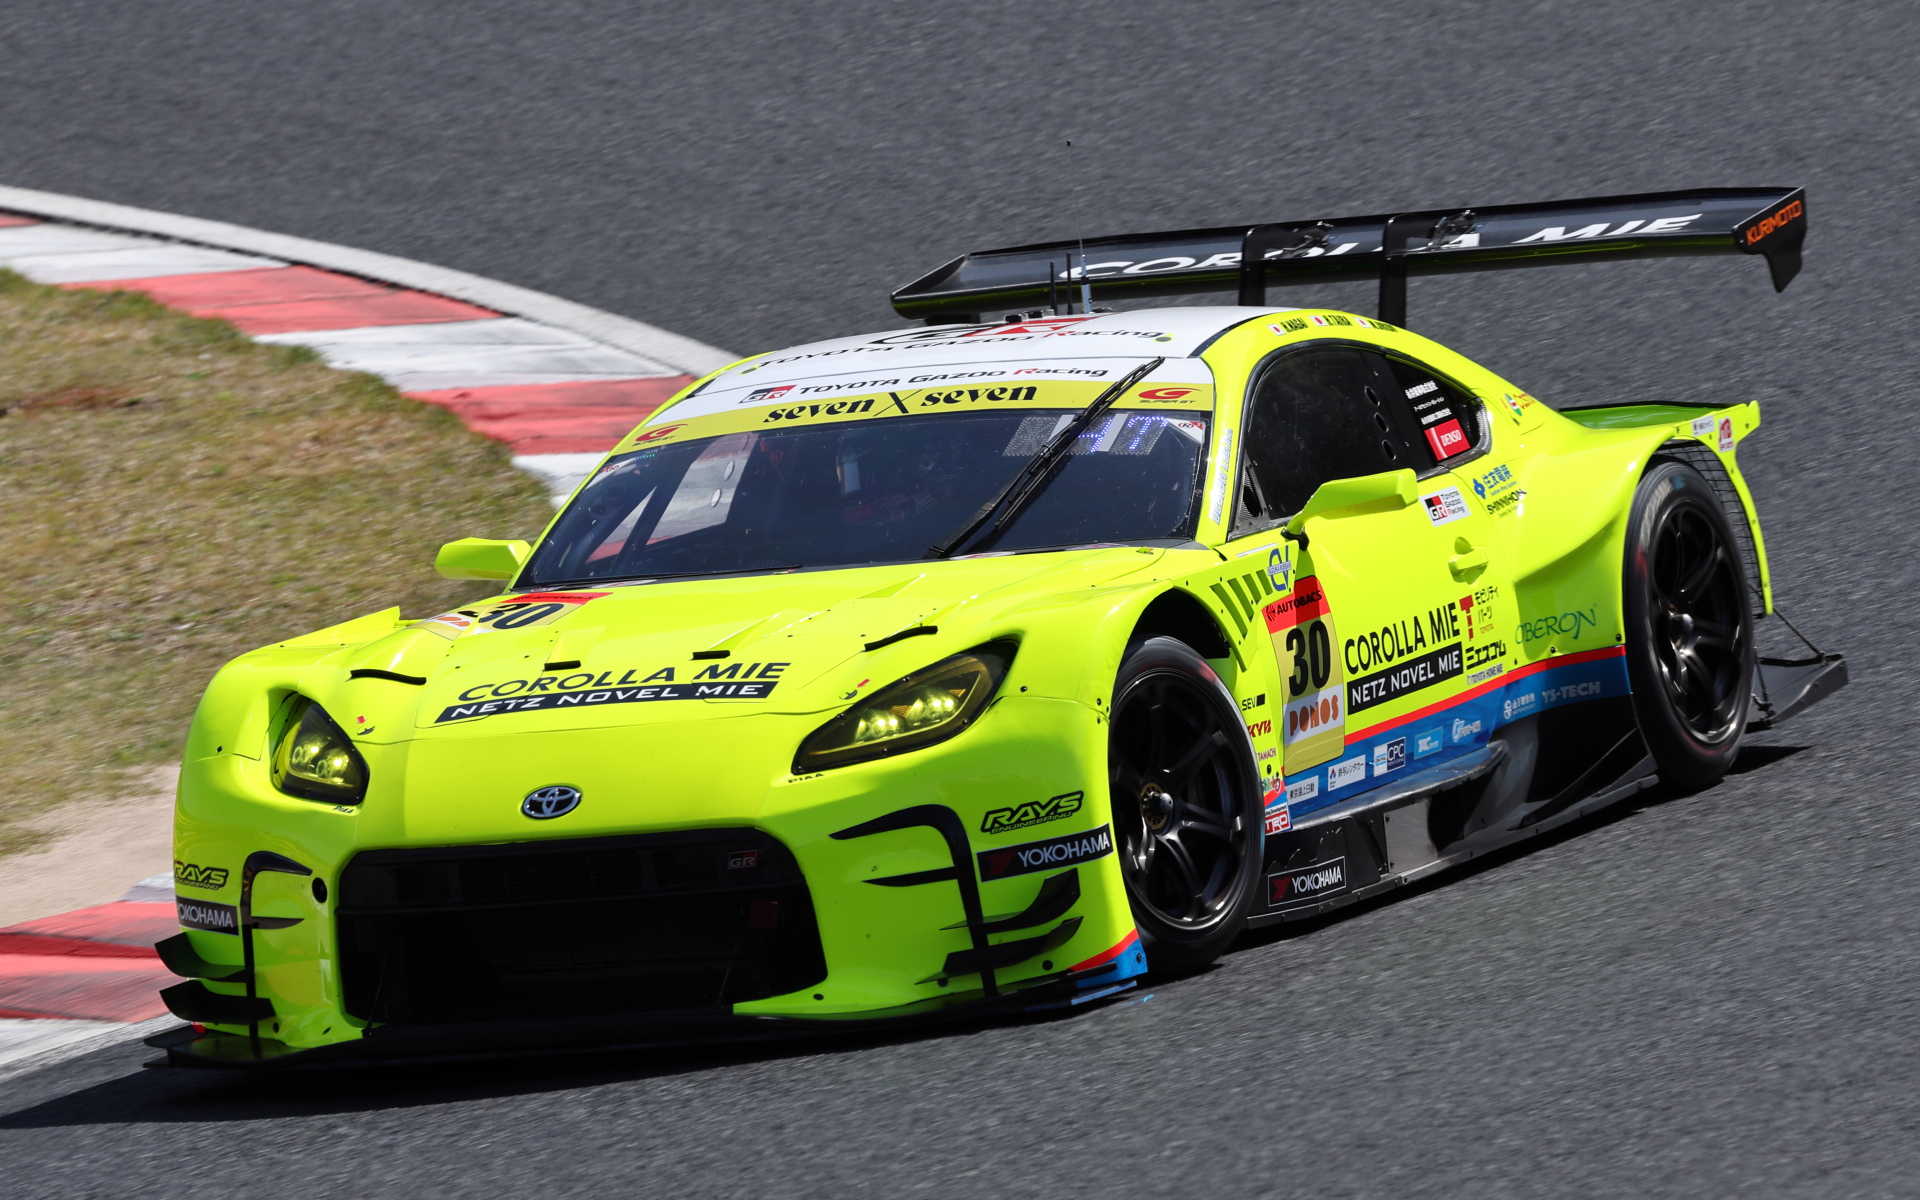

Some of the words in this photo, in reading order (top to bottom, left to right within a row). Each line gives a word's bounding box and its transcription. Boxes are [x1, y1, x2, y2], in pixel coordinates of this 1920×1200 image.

[1511, 213, 1703, 244] MIE
[1746, 200, 1803, 246] KURIMOTO
[757, 345, 894, 368] TOYOTA
[903, 336, 1034, 350] GAZOO
[1042, 330, 1165, 340] Racing
[800, 377, 900, 395] TOYOTA
[908, 370, 1005, 384] GAZOO
[1013, 367, 1109, 378] Racing
[763, 399, 875, 423] seven
[873, 389, 923, 417] X
[920, 385, 1038, 407] seven
[1440, 429, 1463, 447] DENSO
[1430, 502, 1448, 521] GR
[1447, 506, 1466, 517] Racing
[1277, 590, 1322, 615] AUTOBACS
[457, 603, 565, 629] 30
[1515, 609, 1596, 645] OBERON
[1345, 615, 1426, 675] COROLLA
[1428, 601, 1460, 645] MIE
[1286, 620, 1331, 697] 30
[1465, 640, 1507, 670] ミエスコム
[458, 667, 675, 701] COROLLA
[693, 662, 791, 680] MIE
[1352, 677, 1386, 706] NETZ
[1391, 661, 1435, 692] NOVEL
[1438, 650, 1461, 675] MIE
[450, 697, 547, 718] NETZ
[556, 688, 680, 705] NOVEL
[695, 685, 764, 697] MIE
[1242, 700, 1256, 711] SEV
[1289, 695, 1339, 736] PONOS
[1248, 720, 1272, 738] KYB
[1258, 747, 1276, 761] TAMACHI
[1387, 743, 1405, 760] CPC
[788, 773, 824, 783] PIAA
[983, 794, 1083, 830] RAYS
[990, 812, 1072, 834] ENGINEERING
[1265, 814, 1290, 832] TRD
[730, 857, 755, 867] GR
[1018, 832, 1110, 867] YOKOHAMA
[174, 862, 229, 887] RAYS
[1292, 871, 1342, 893] YOKOHAMA
[179, 903, 233, 928] OKOHAMA
